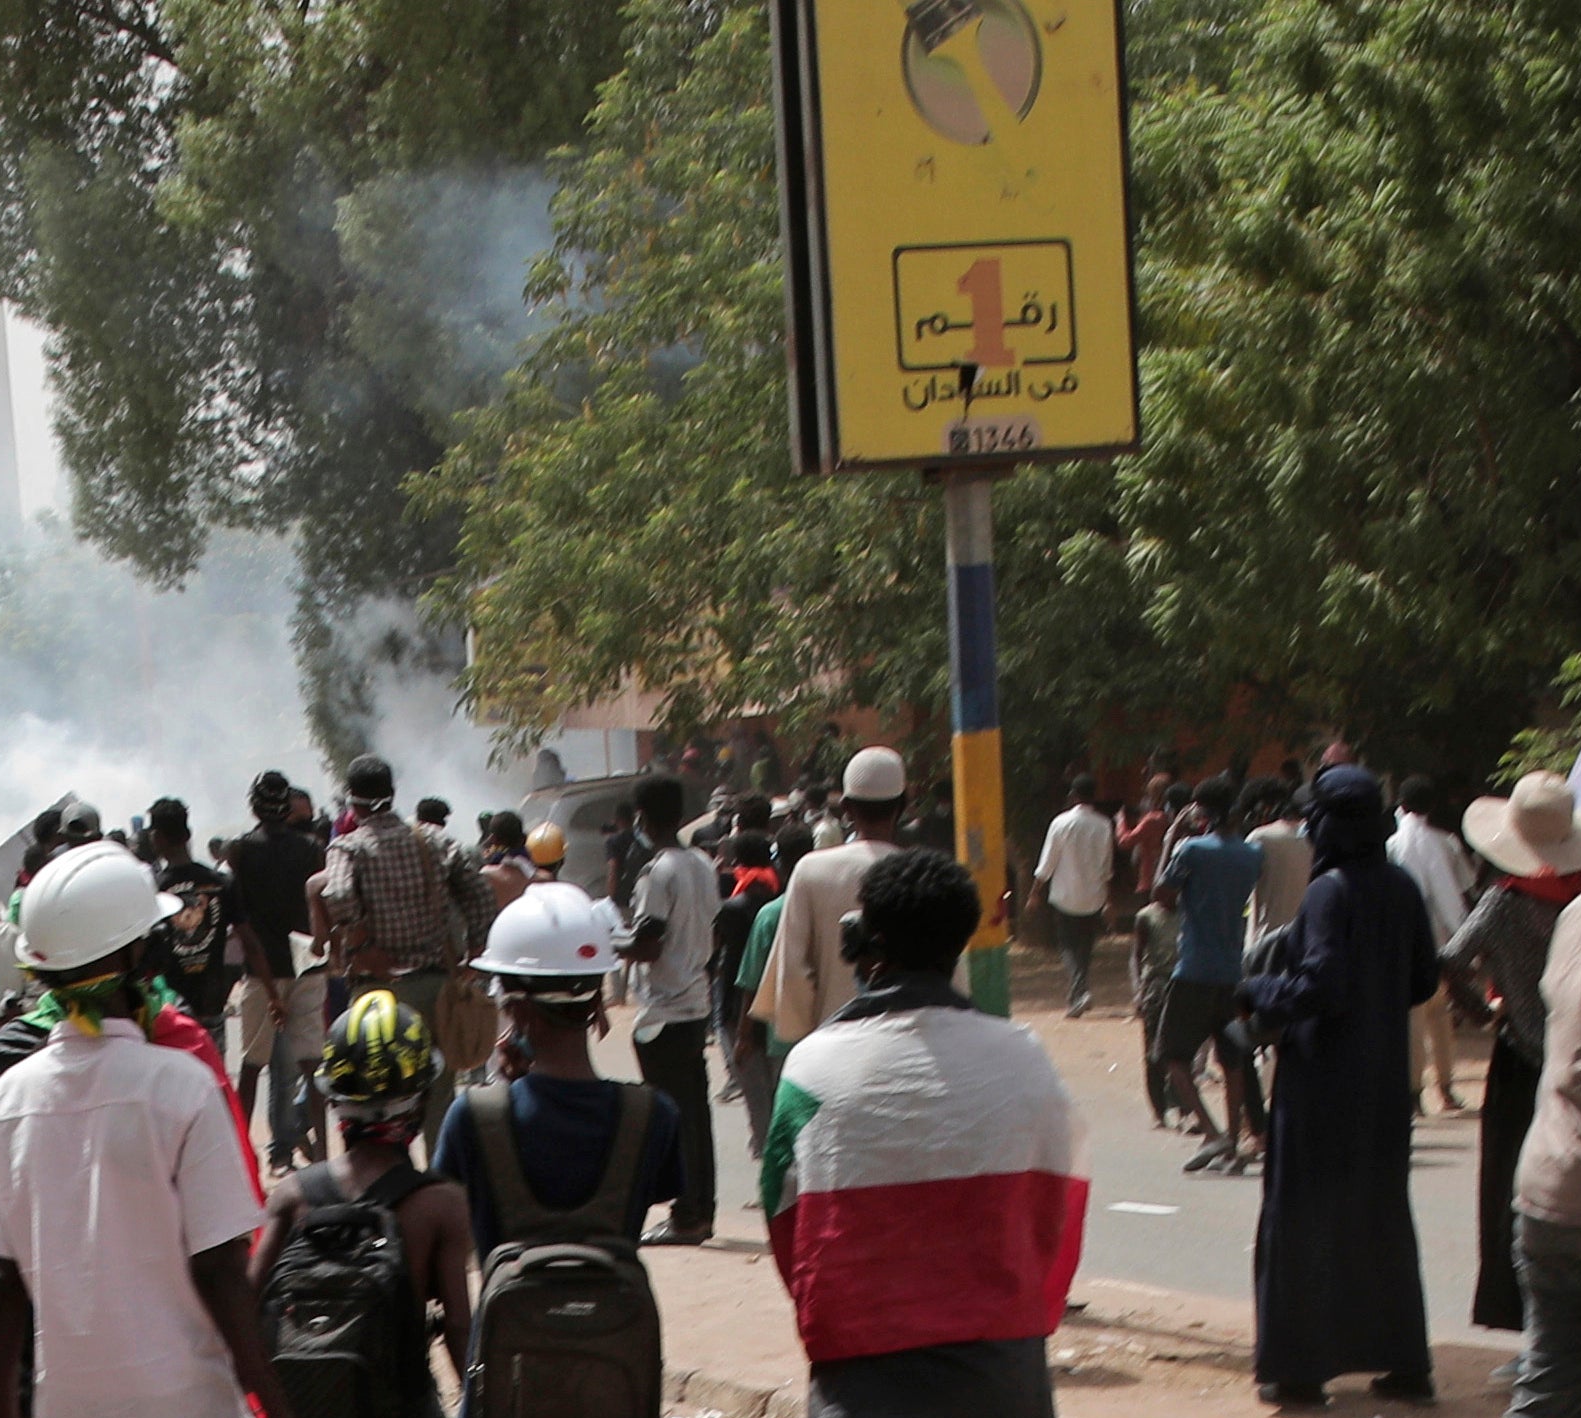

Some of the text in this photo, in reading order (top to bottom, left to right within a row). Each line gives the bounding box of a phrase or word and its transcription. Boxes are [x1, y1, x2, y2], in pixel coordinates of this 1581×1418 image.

[914, 258, 1059, 367] رقم 1
[902, 370, 1022, 411] السدان
